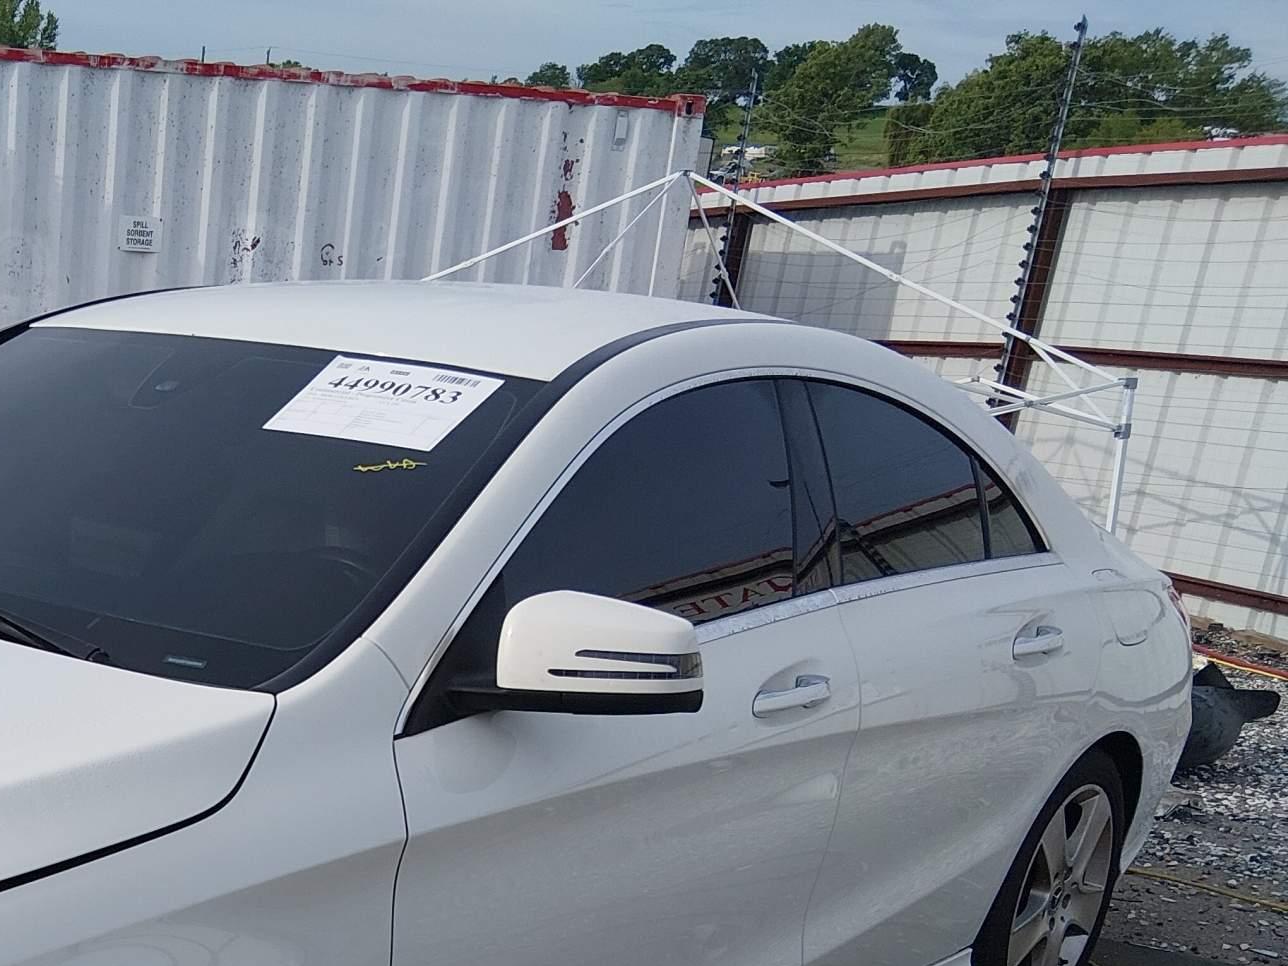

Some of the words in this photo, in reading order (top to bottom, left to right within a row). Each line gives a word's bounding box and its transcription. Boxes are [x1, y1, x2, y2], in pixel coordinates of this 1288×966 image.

[132, 220, 149, 229] SPILL
[125, 237, 153, 247] STORAGE
[328, 375, 463, 404] 44990783
